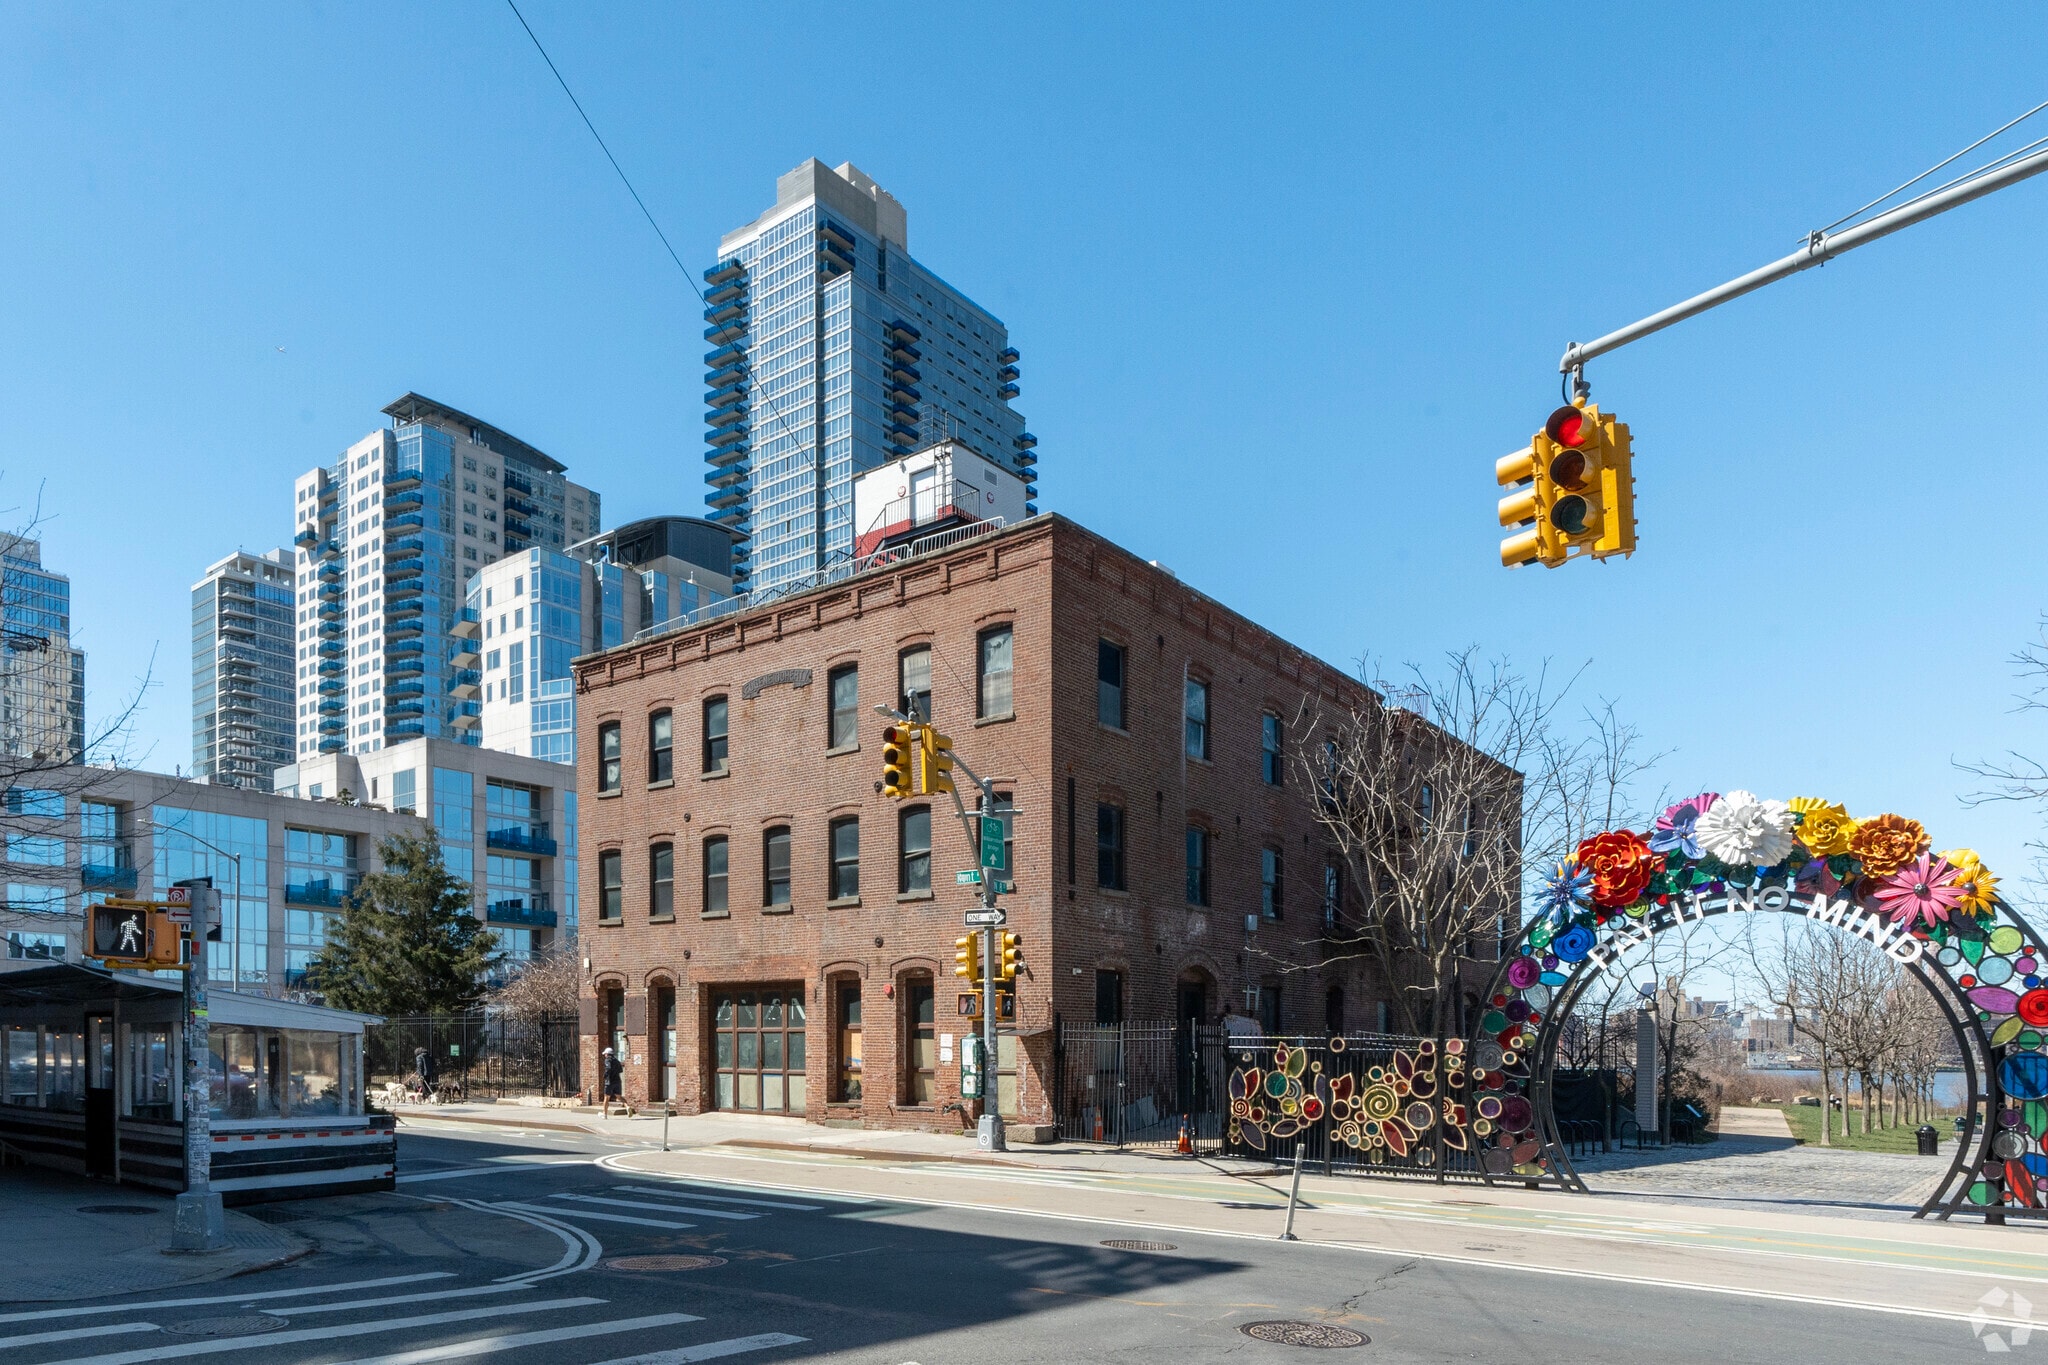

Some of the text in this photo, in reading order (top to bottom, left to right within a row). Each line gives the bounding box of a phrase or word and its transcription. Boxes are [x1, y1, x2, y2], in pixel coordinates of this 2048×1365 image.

[1587, 886, 1923, 970] PAY IT NO MIND
